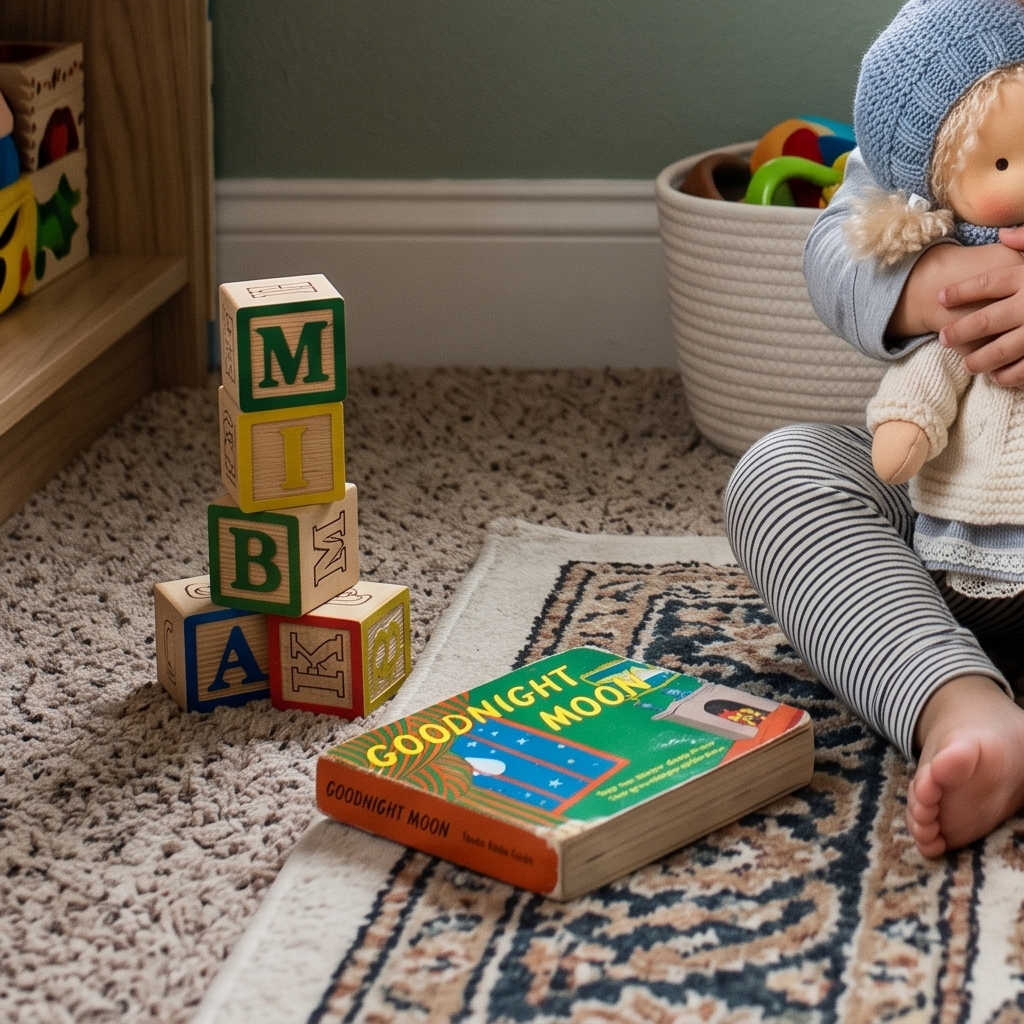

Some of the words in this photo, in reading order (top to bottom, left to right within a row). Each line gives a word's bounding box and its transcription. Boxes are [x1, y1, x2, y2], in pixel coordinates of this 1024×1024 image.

[255, 320, 330, 389] M
[279, 426, 309, 490] I
[229, 526, 282, 594] B
[207, 625, 270, 692] A
[290, 631, 345, 698] K
[366, 665, 579, 767] GOODNIGHT
[539, 671, 652, 731] MOON
[325, 780, 405, 821] GOODNIGHT
[407, 809, 451, 838] MOON
